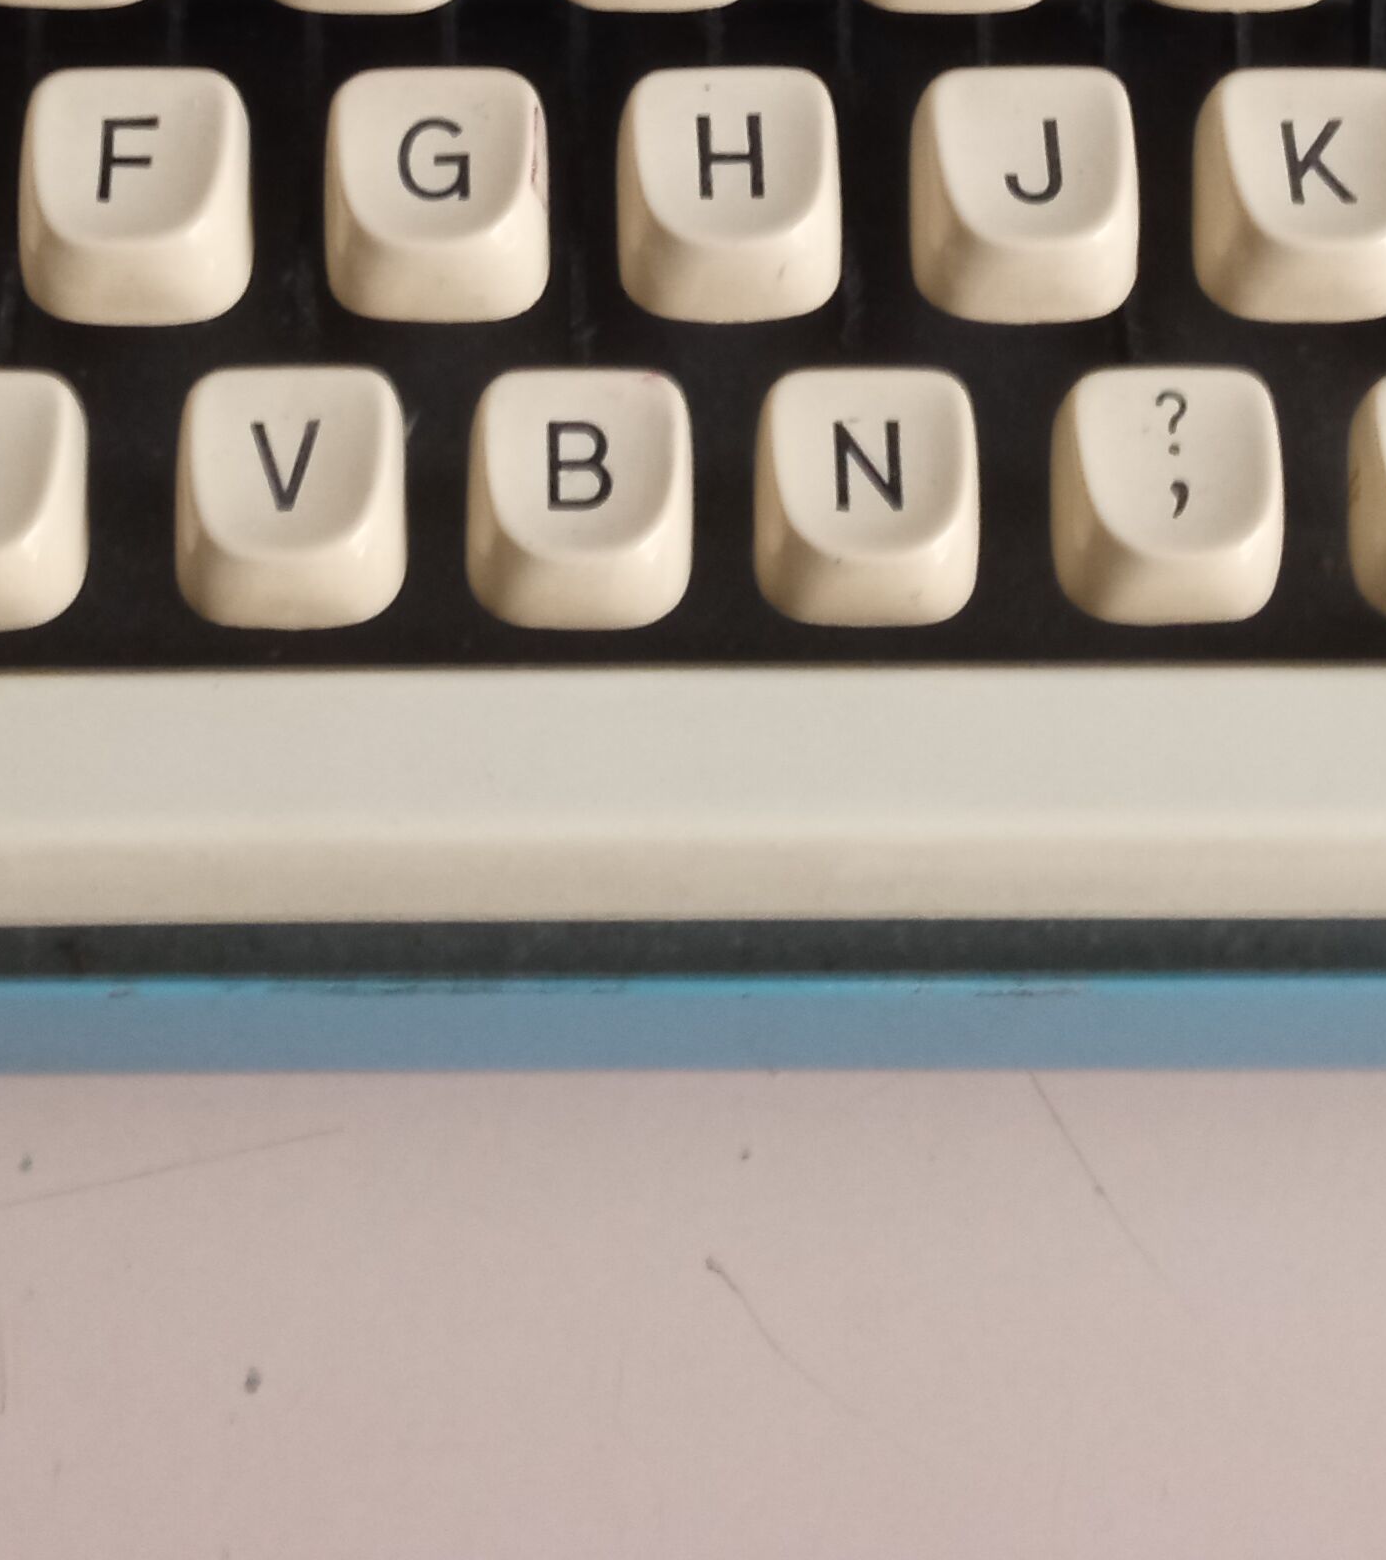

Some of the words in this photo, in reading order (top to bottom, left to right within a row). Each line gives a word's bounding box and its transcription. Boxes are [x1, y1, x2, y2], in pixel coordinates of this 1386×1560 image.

[96, 115, 160, 203] F
[397, 116, 471, 202] G
[695, 112, 765, 200] H
[1004, 118, 1063, 205] J
[1280, 118, 1358, 205] K
[250, 418, 321, 512] V
[546, 420, 614, 512] B
[832, 419, 904, 512] N
[1155, 389, 1188, 456] ?
